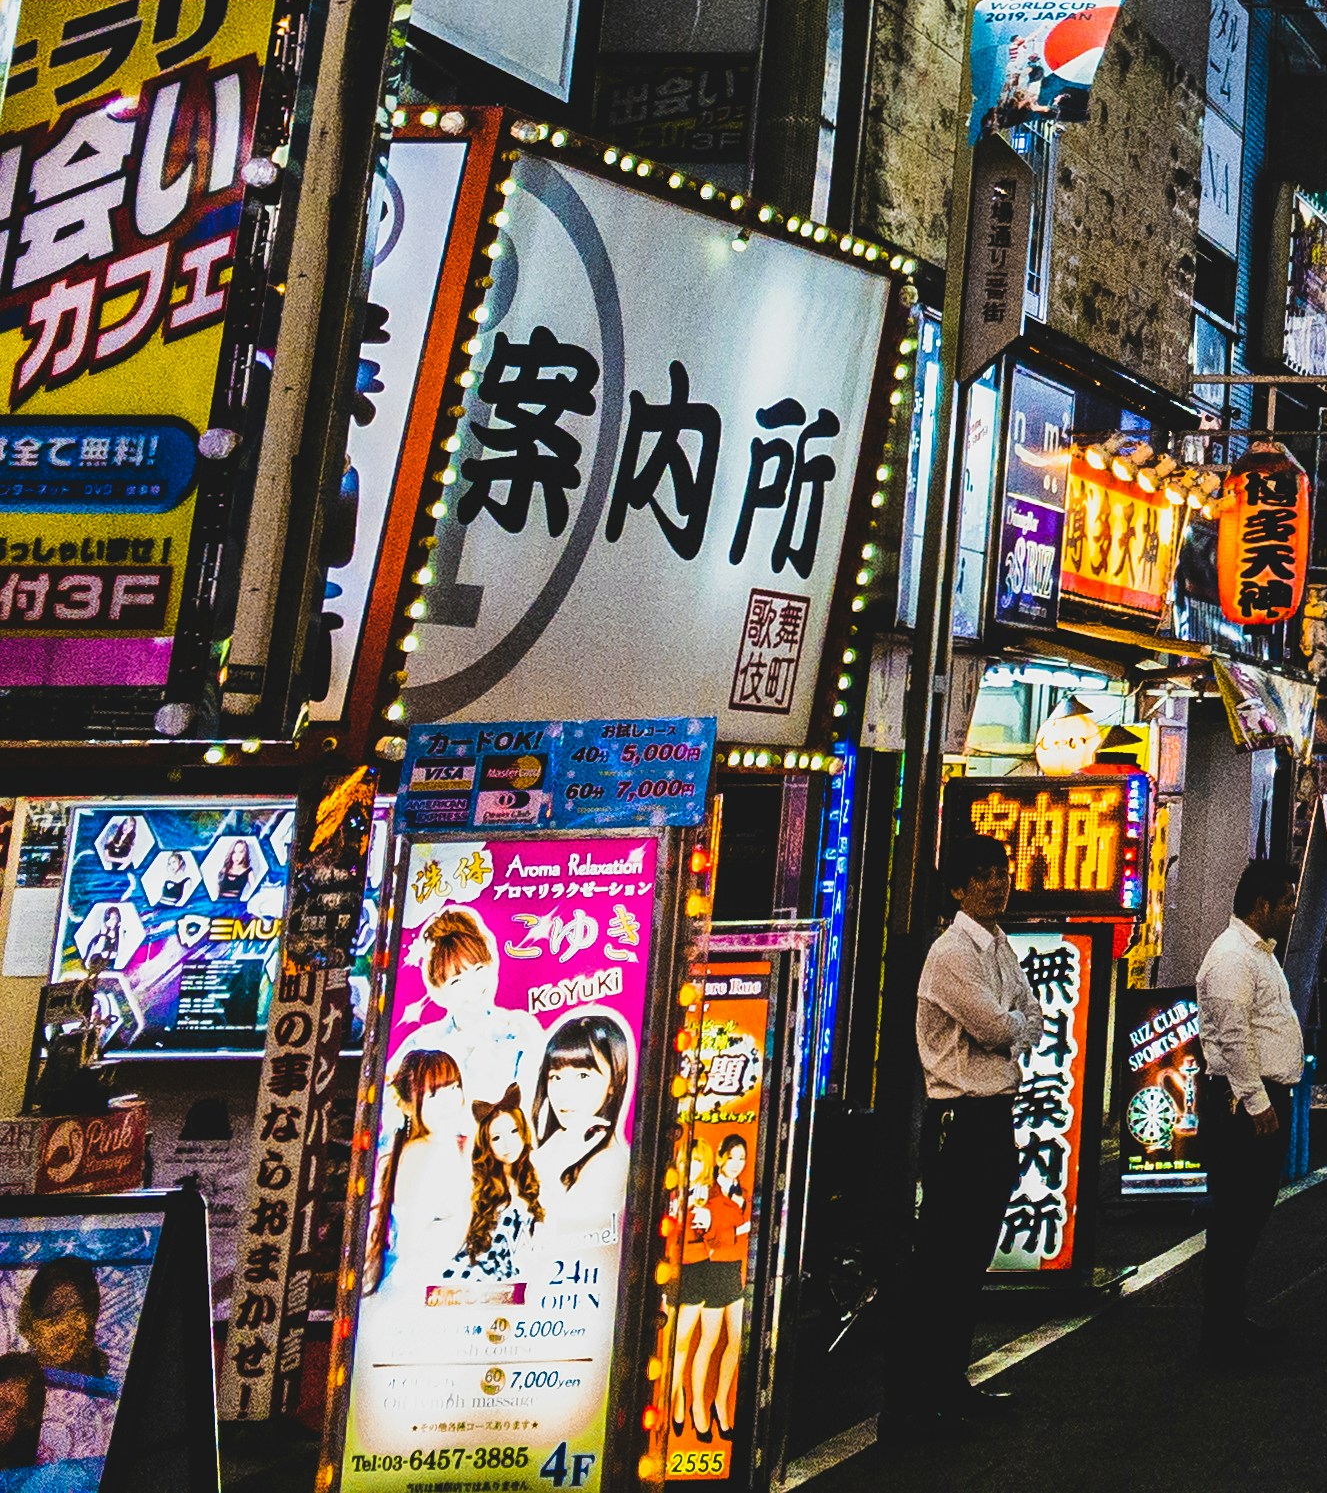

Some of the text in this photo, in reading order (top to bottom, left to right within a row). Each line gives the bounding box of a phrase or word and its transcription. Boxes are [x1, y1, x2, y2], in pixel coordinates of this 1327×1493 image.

[985, 11, 1092, 24] 2019, JAPAN
[989, 0, 1097, 12] WORLD CUP
[456, 325, 841, 581] 案内所
[427, 730, 543, 755] カードOK!
[620, 743, 701, 765] 5,000円
[424, 766, 466, 781] VISA
[615, 779, 695, 800] 7,000円
[504, 855, 643, 878] Aroma Relaxation
[492, 881, 652, 900] アロマリラクゼーション
[504, 905, 642, 964] こゆき
[1128, 1005, 1186, 1049] RIZ CLUB
[1127, 1030, 1180, 1073] SPORTS
[540, 1293, 600, 1311] OPEN
[539, 1441, 596, 1488] 4F
[670, 1451, 724, 1474] 2555
